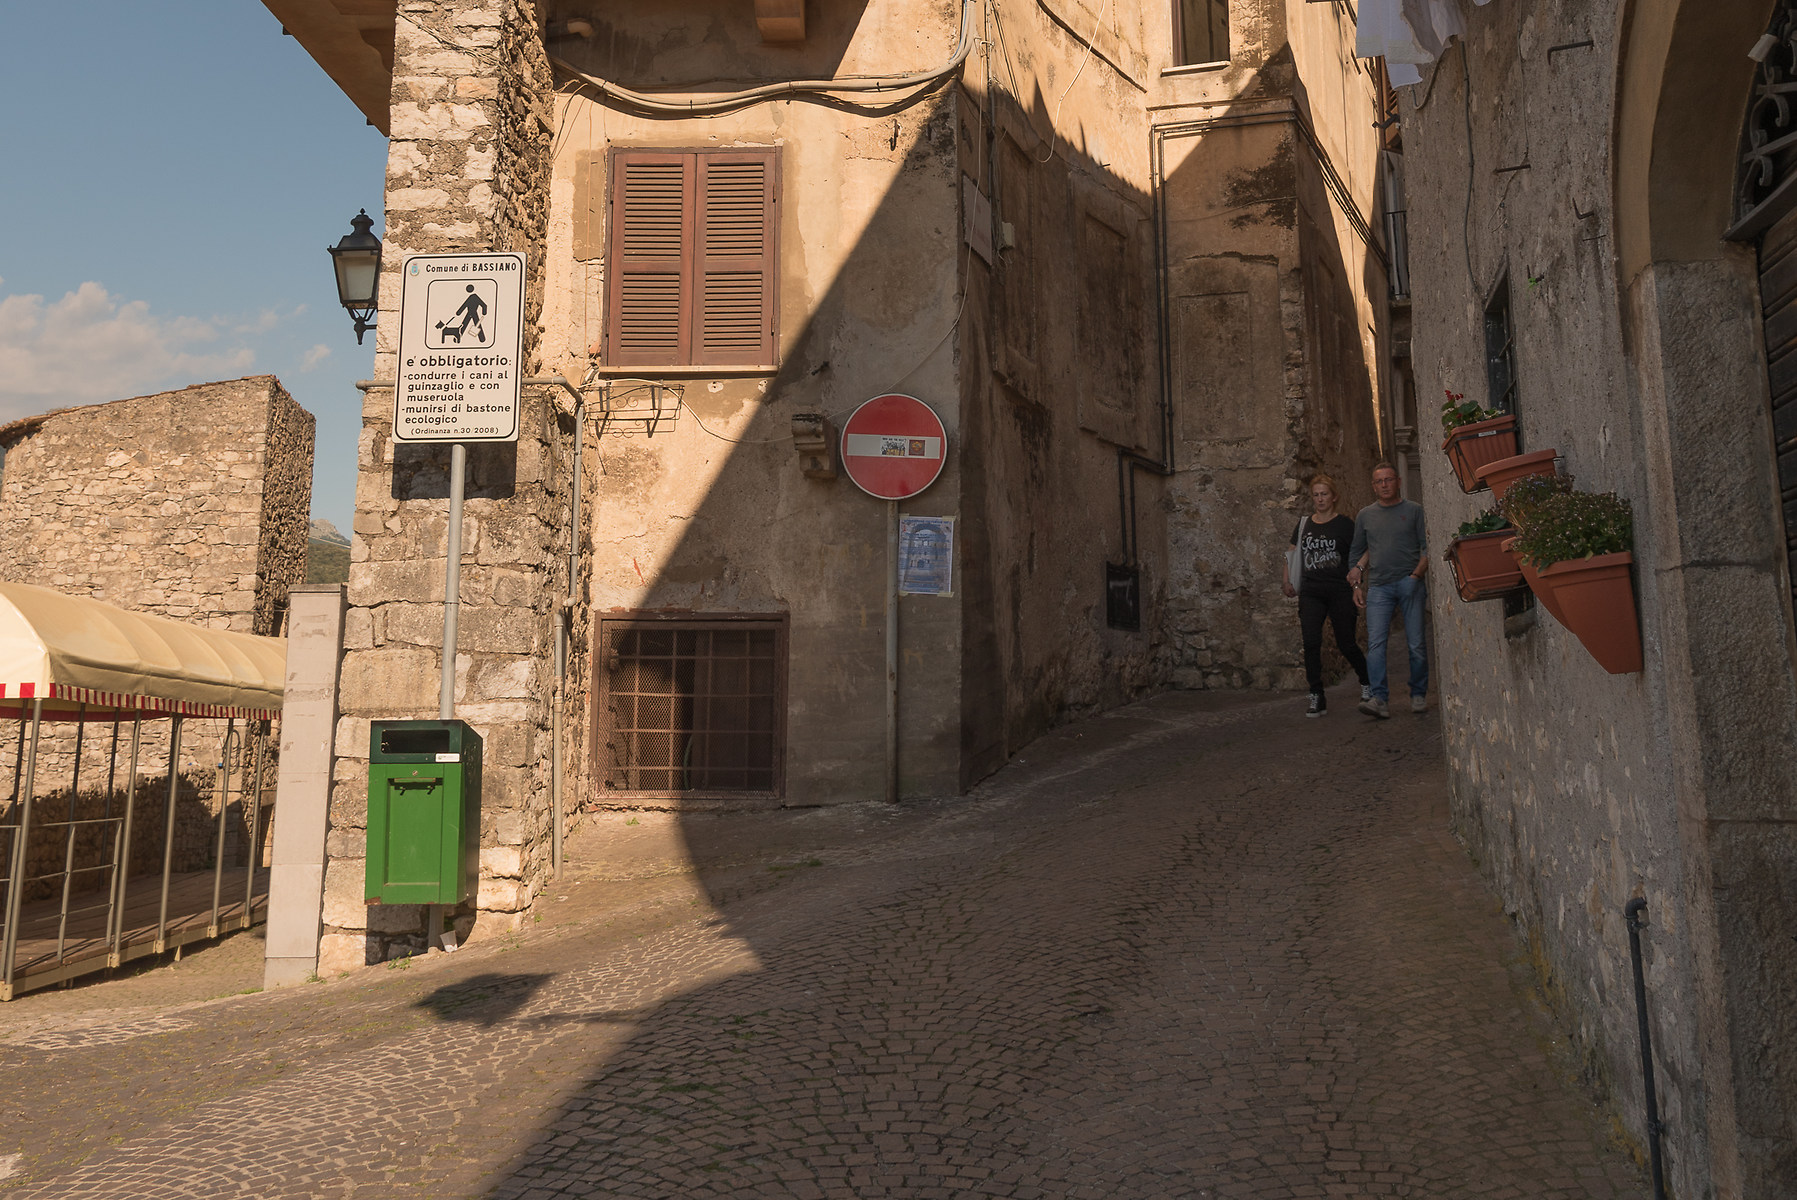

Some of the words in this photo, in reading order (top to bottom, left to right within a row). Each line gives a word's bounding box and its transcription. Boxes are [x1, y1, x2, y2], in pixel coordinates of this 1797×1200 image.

[425, 264, 459, 273] Comune
[461, 263, 469, 272] di
[472, 262, 517, 272] BASSIANO
[419, 355, 512, 368] obbligatorio:
[403, 371, 457, 380] -condurre
[461, 371, 465, 379] i
[469, 371, 493, 379] cani
[497, 371, 508, 379] al
[407, 381, 464, 392] guinzaglio
[480, 382, 500, 390] con
[407, 392, 464, 402] museruola
[401, 404, 447, 413] -munirsi
[451, 404, 461, 413] di
[466, 404, 511, 413] bastone
[405, 415, 458, 425] ecologico
